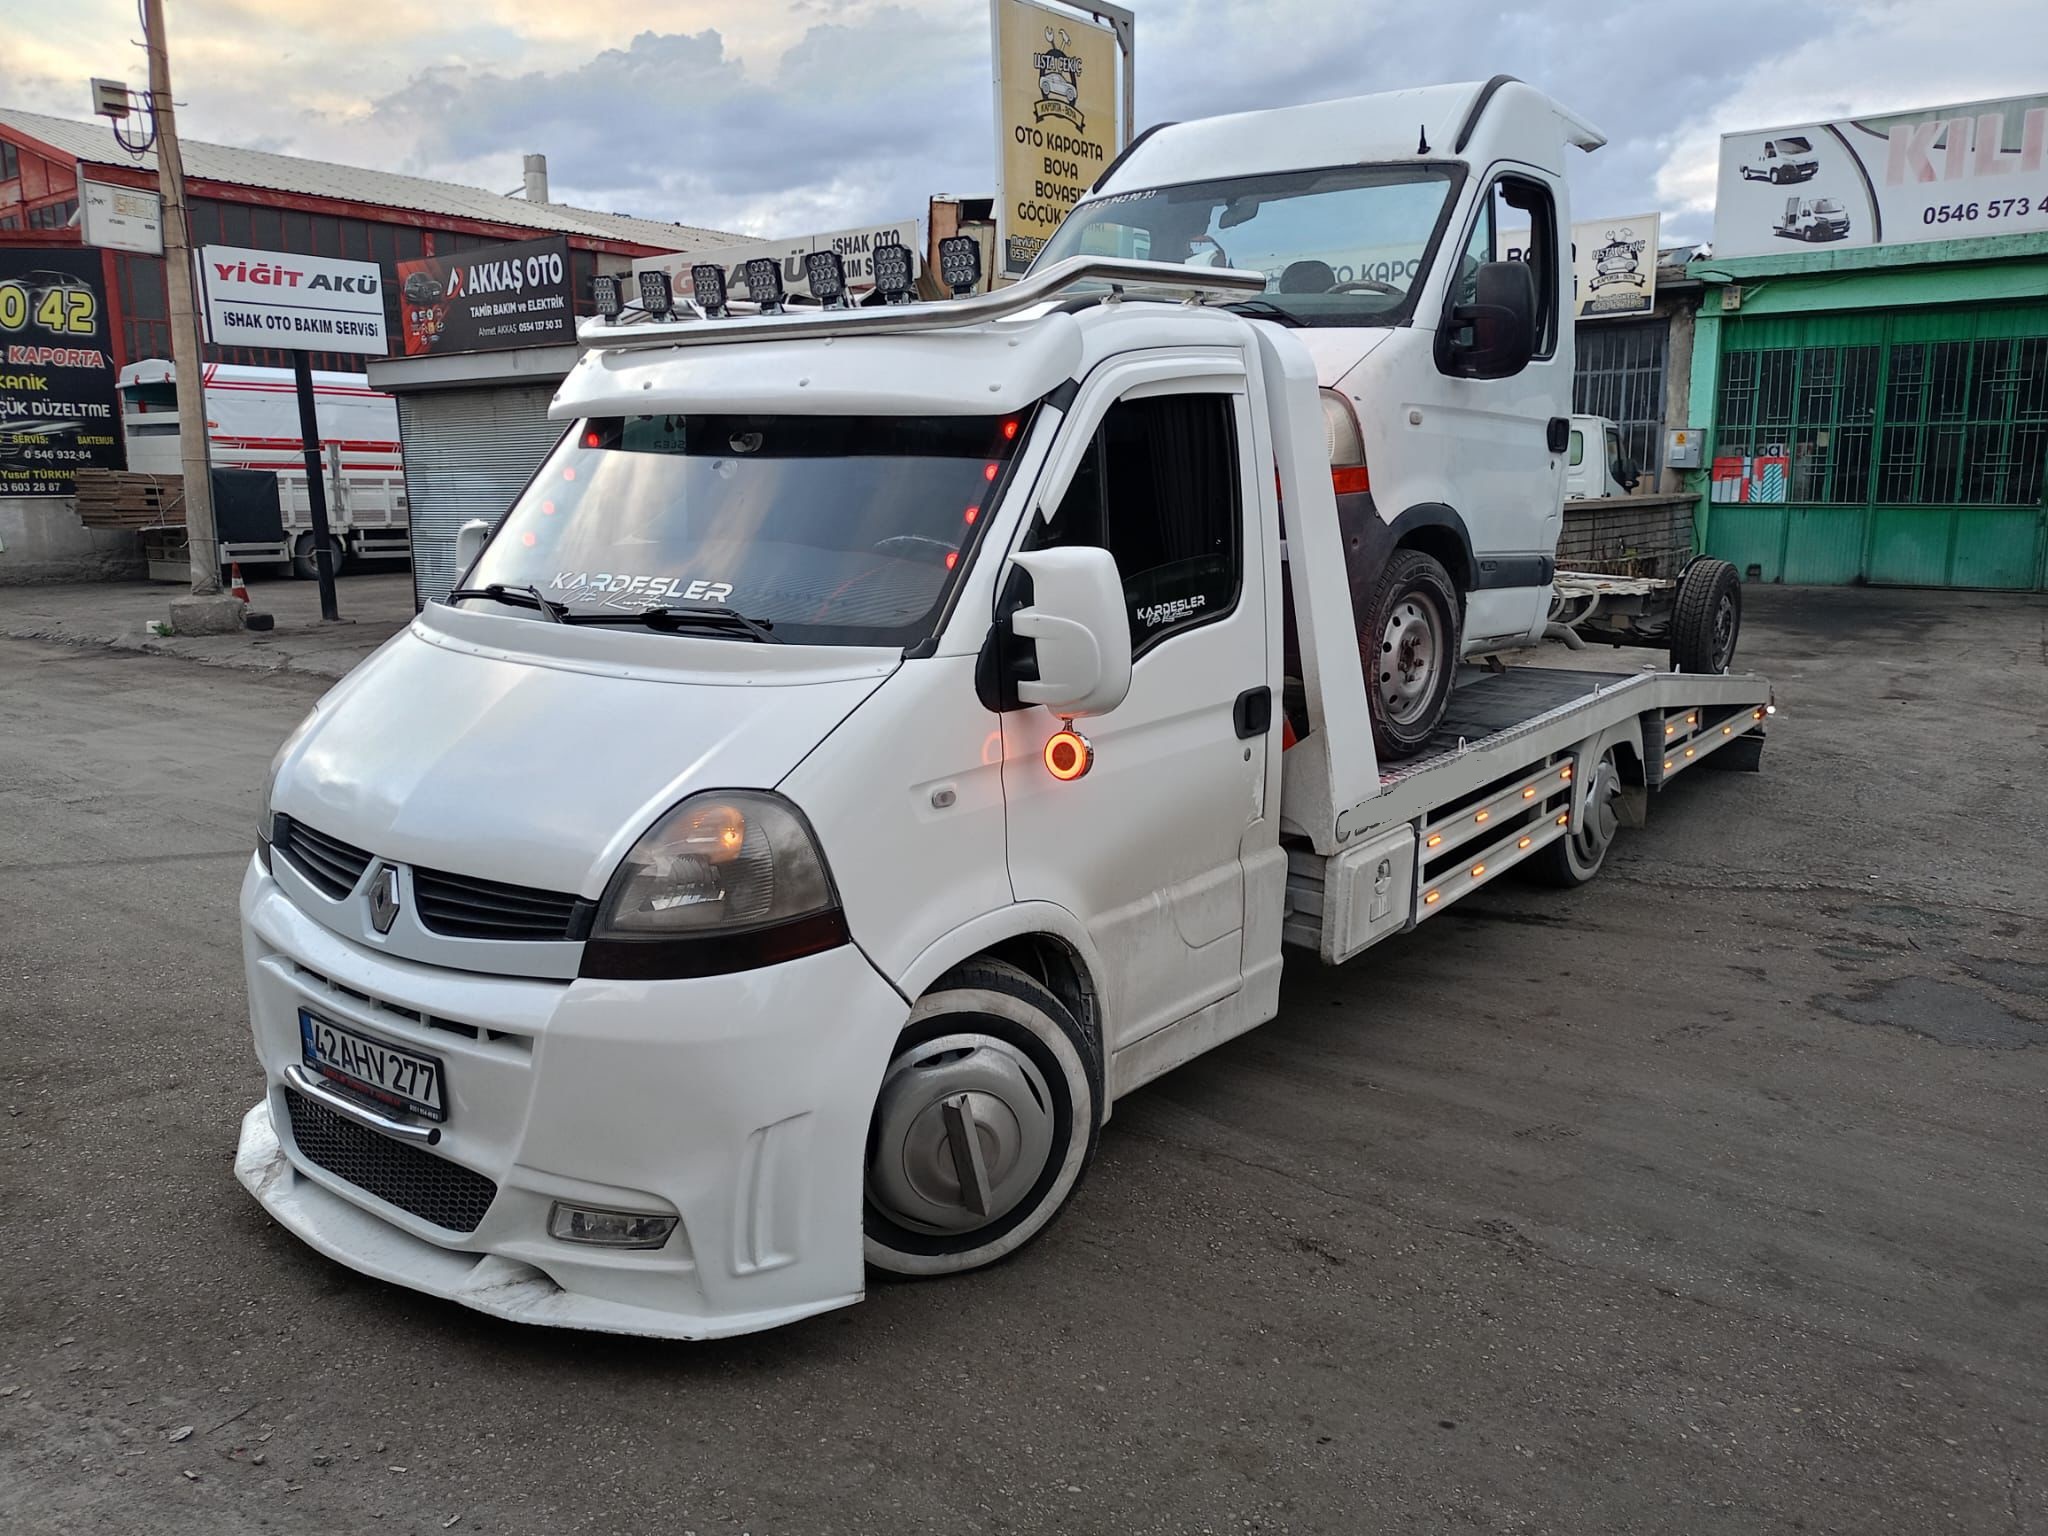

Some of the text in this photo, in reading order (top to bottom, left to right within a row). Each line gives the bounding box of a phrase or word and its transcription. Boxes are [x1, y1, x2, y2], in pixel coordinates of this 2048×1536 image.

[1015, 125, 1103, 161] OTO KAPORTA
[1044, 157, 1078, 180] BOYA
[1018, 201, 1061, 227] GÖÇÜK
[1923, 206, 1979, 225] 0546
[1987, 197, 2030, 219] 573
[213, 261, 377, 295] YİĞİT AKÜ
[468, 252, 563, 295] AKKAŞ OTO
[37, 287, 95, 334] 42
[470, 294, 564, 318] TAMİR BAKIM ve ELEKTRİK
[266, 315, 291, 331] OTO
[295, 317, 333, 334] BAKIM
[9, 345, 104, 369] KAPORTA
[31, 398, 111, 417] DÜZELTME
[24, 450, 31, 459] 0
[34, 450, 54, 459] 546
[1, 470, 30, 479] Yusuf
[11, 482, 31, 492] 603
[33, 482, 46, 492] 28
[1136, 594, 1206, 620] KARDESLER
[388, 1054, 435, 1102] 277
